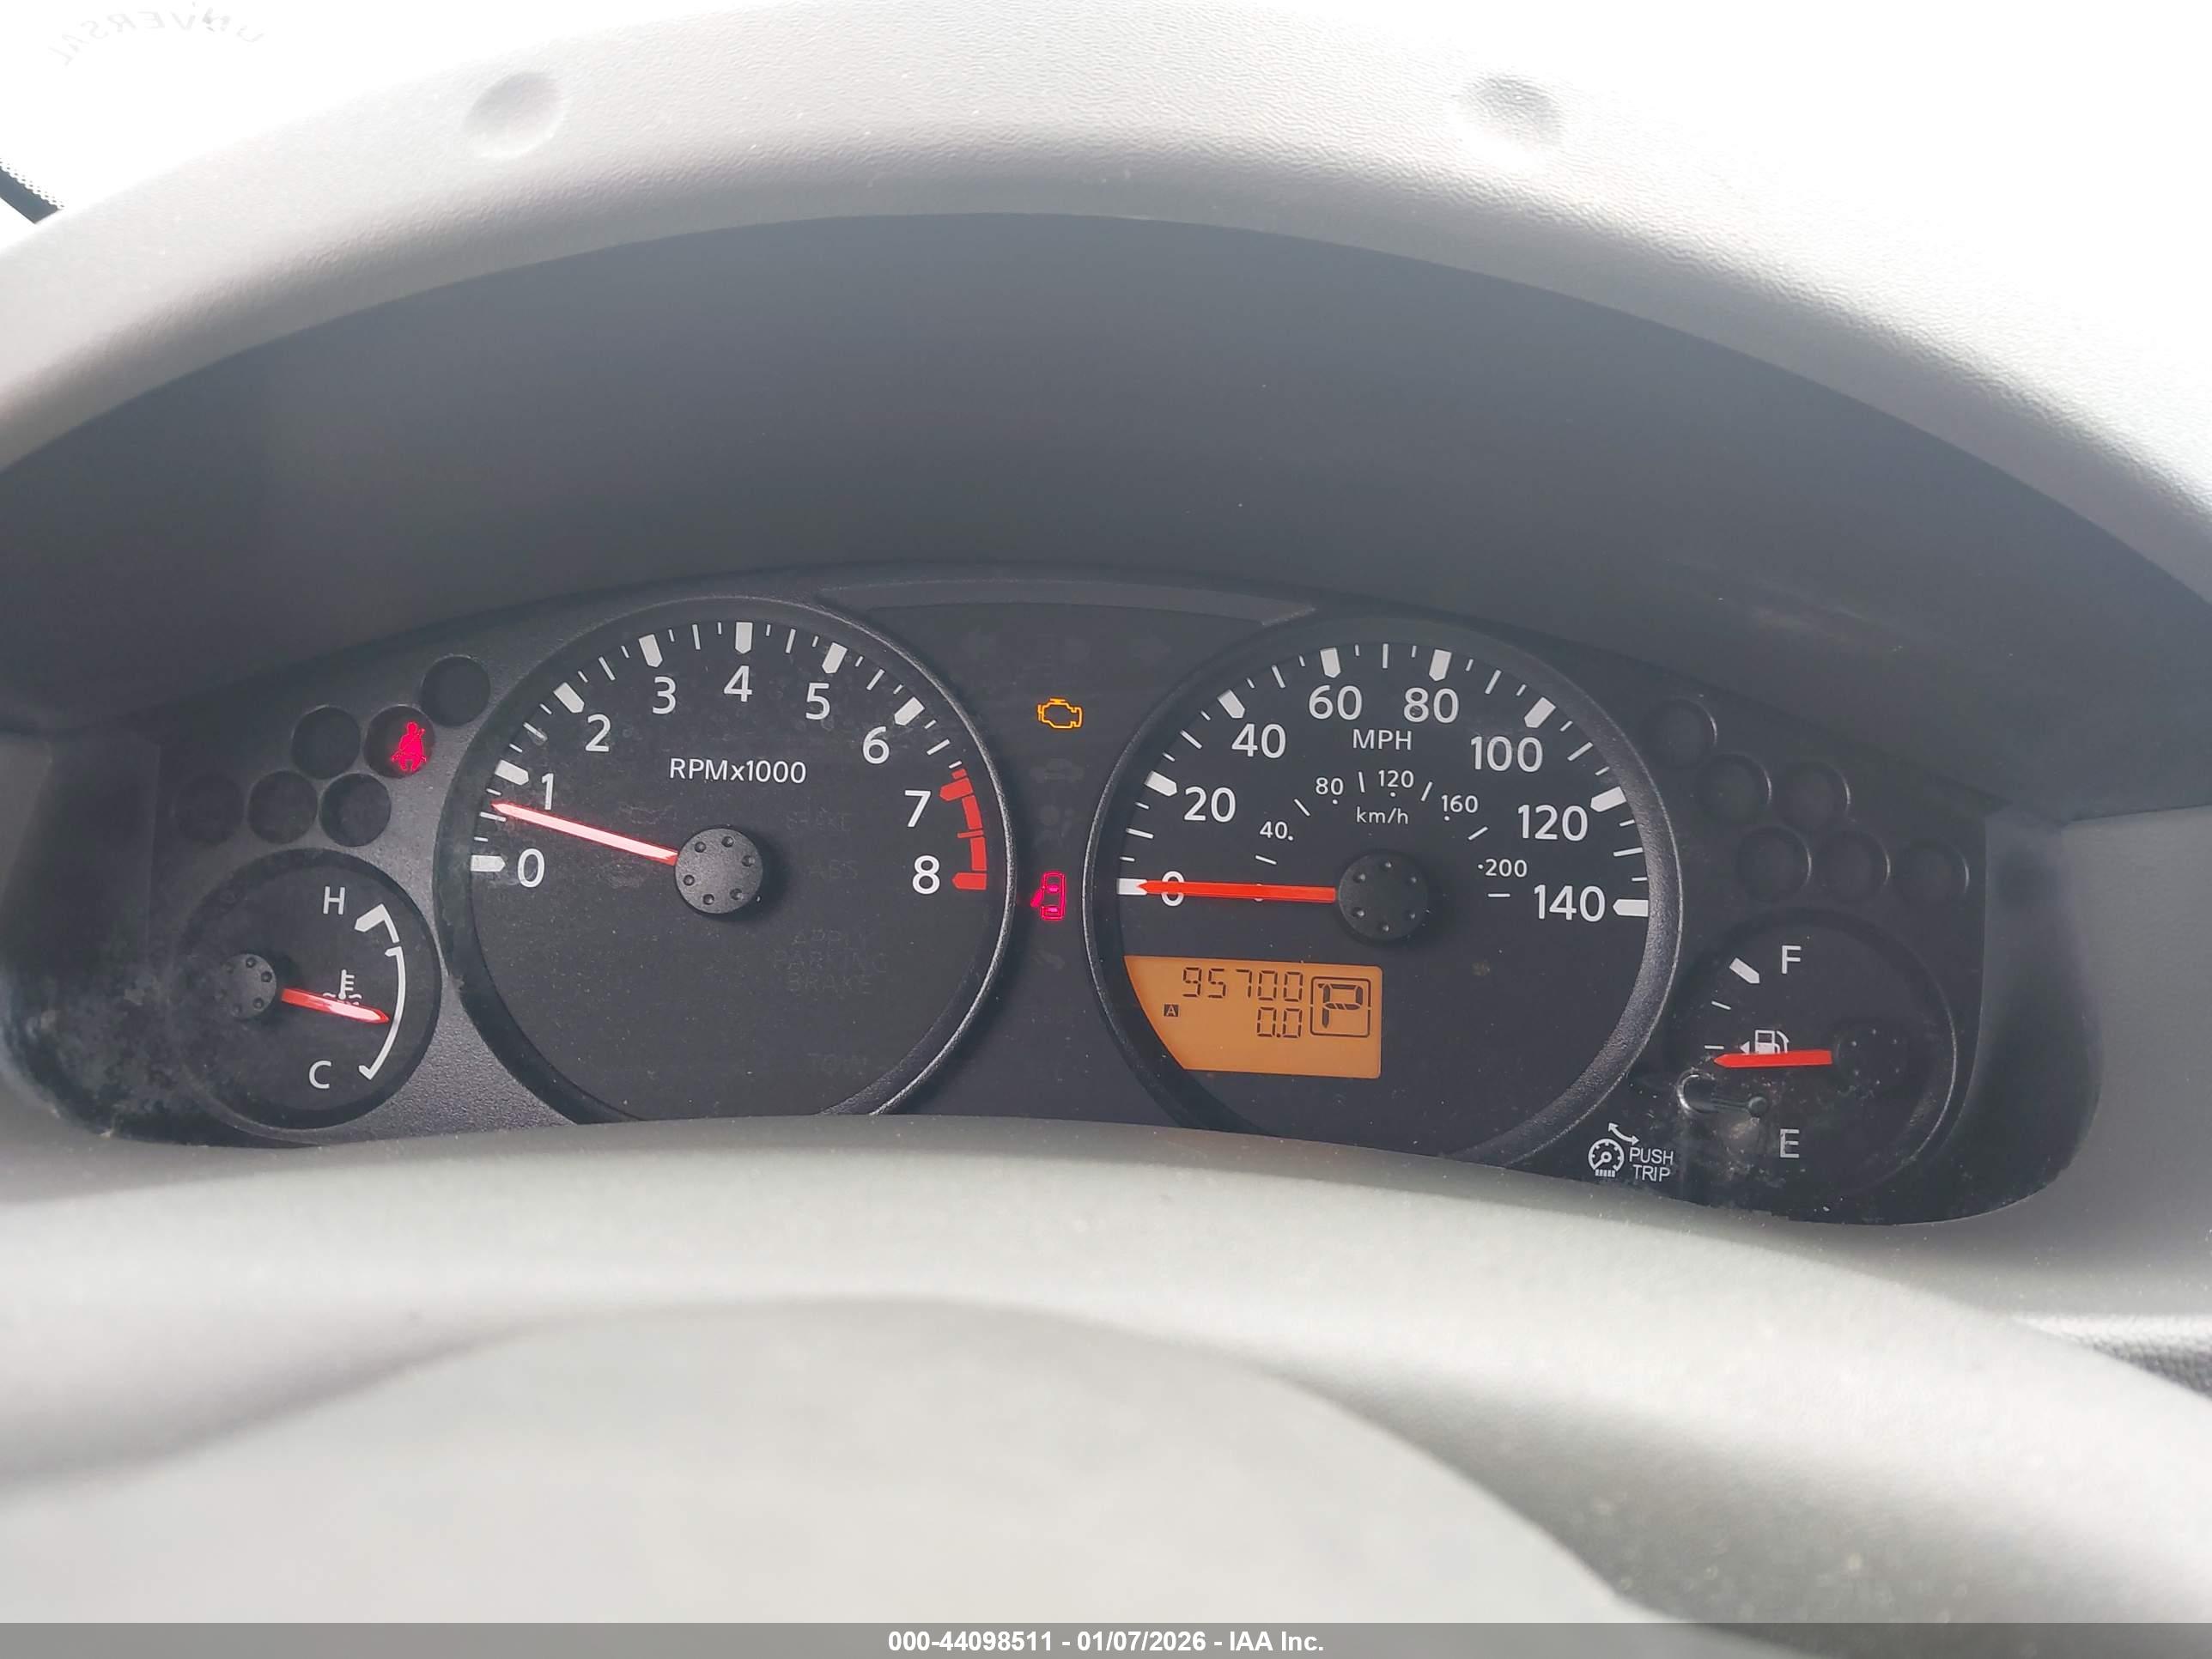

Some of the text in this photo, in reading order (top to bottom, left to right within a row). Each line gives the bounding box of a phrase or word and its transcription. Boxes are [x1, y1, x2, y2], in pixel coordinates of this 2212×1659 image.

[653, 677, 676, 714] 3
[724, 665, 752, 702] 4
[806, 683, 830, 720] 5
[1310, 685, 1362, 720] 60
[1404, 688, 1458, 723] 80
[586, 714, 611, 751] 2
[863, 726, 889, 763] 6
[1232, 724, 1285, 758] 40
[1353, 729, 1411, 750] MPH
[671, 758, 805, 783] RPMx1000
[1471, 737, 1542, 772] 100
[542, 774, 553, 810] 1
[1316, 778, 1343, 795] 80
[1379, 770, 1413, 787] 120
[905, 790, 931, 827] 7
[1184, 787, 1235, 822] 20
[1357, 806, 1407, 823] km/h
[1442, 795, 1478, 812] 160
[1260, 822, 1287, 839] 40
[1518, 805, 1587, 841] 120
[518, 848, 544, 887] 0
[913, 855, 939, 894] 8
[1486, 859, 1527, 877] 200
[324, 886, 345, 915] H
[1162, 872, 1184, 906] 0
[1534, 884, 1605, 921] 140
[1782, 945, 1801, 974] F
[1183, 967, 1303, 1002] 95700
[1163, 1004, 1180, 1018] A
[1257, 1007, 1303, 1038] 0.0
[1318, 983, 1363, 1028] P
[309, 1060, 331, 1089] C
[1630, 1147, 1673, 1166] PUSH
[1780, 1129, 1799, 1158] E
[1633, 1165, 1670, 1182] TRIP
